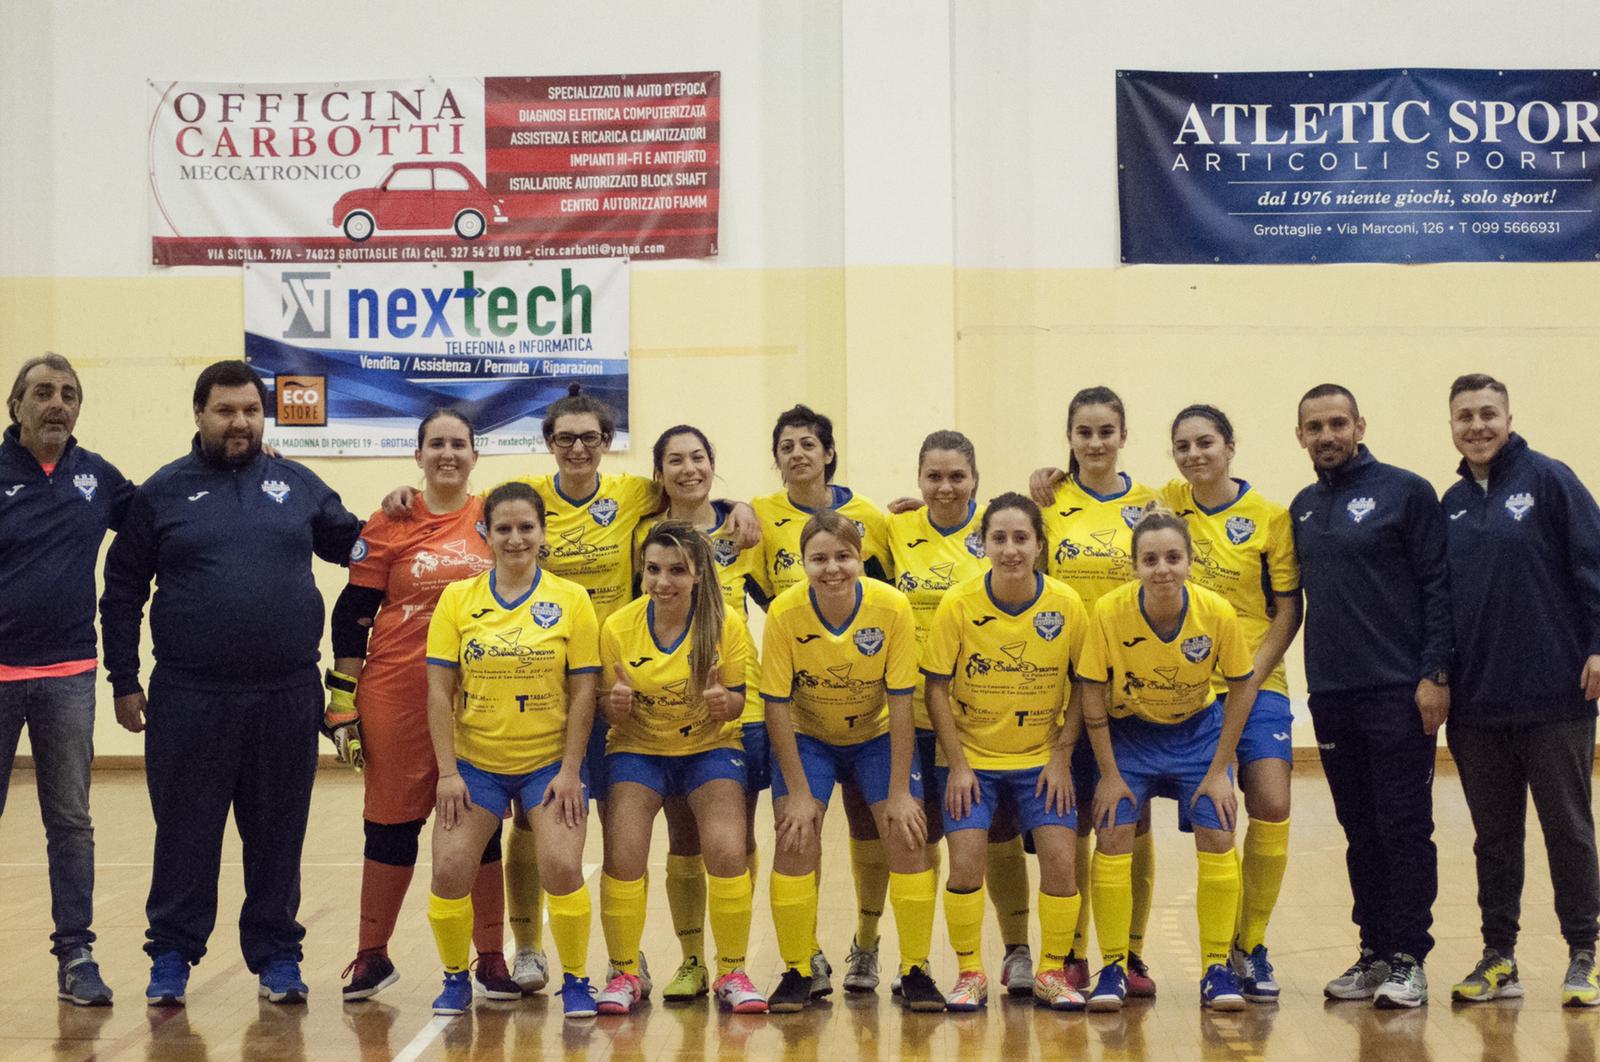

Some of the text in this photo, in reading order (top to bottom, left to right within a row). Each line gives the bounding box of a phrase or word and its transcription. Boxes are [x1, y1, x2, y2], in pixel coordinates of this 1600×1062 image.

[548, 82, 706, 100] SPECIALIZZATO IN AUTO D'EPOCA
[173, 88, 466, 123] OFFICINA
[519, 104, 706, 123] DIAGNOSI ELETTRICA COMPUTERIZZATA
[1173, 100, 1600, 145] ATLETIC SPOR
[175, 123, 465, 158] CARBOTTI
[510, 127, 706, 146] ASSISTENZA E RICARICA CLIMATIZZATORI
[570, 150, 706, 167] IMPIANTI HI-FI E ANTIFURTO
[1172, 151, 1586, 171] ARTICOLI SPORTI
[179, 163, 361, 181] MECCATRONICO
[510, 172, 707, 190] ISTALLATORE AUTORIZZATO BLOCK SHAFT
[561, 195, 707, 212] CENTRO AUTORIZZATO FIAMM
[1258, 189, 1557, 210] dal 1976 niente giochi, solo sport!
[1254, 222, 1561, 238] Grottaglie Via Marconi, 126 T 099 5666931
[208, 248, 225, 261] VIA
[270, 247, 292, 261] 79/A
[305, 247, 336, 260] 74023
[338, 247, 399, 260] GROTTAGLIE
[401, 247, 421, 260] (TA)
[424, 246, 447, 259] Cell.
[450, 246, 469, 259] 327
[472, 246, 485, 258] 54
[487, 246, 500, 258] 20
[503, 245, 522, 257] 890
[535, 243, 665, 257] ciro.carbotti@yahoo.com
[348, 267, 592, 338] nextech
[446, 338, 592, 356] TELEFONIA e INFORMATICA
[360, 356, 400, 371] Vendita
[412, 357, 472, 373] Assistenza
[484, 359, 529, 375] Permuta
[543, 359, 604, 376] Riparazioni
[283, 390, 319, 404] ECO
[284, 405, 318, 420] STORE
[282, 438, 320, 448] MADONNA
[321, 438, 330, 448] DI
[331, 438, 361, 448] POMPEI
[363, 438, 372, 448] 19
[380, 438, 418, 448] GROTTAGL
[475, 437, 489, 447] 277
